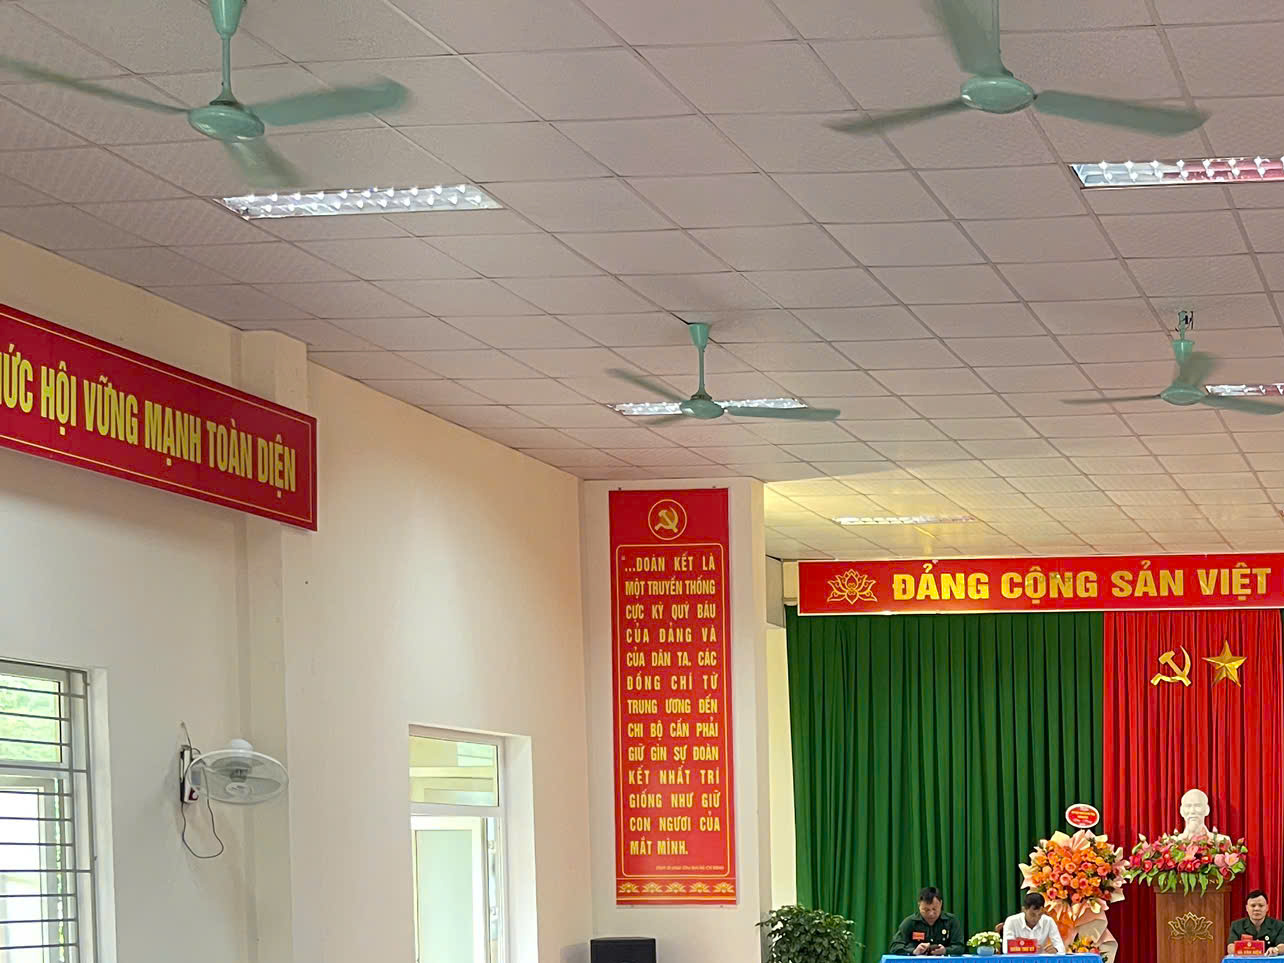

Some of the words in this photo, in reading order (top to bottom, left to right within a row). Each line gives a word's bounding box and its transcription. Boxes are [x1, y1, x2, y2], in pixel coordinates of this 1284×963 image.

[0, 343, 33, 413] ỨC
[41, 361, 76, 435] HỘI
[83, 375, 138, 445] VỮNG
[145, 400, 201, 466] MẠNH
[207, 418, 252, 479] TOÀN
[257, 434, 296, 498] DIỆN
[892, 562, 990, 600] ĐẢNG
[1001, 565, 1097, 604] CỘNG
[1111, 560, 1184, 598] SẢN
[1196, 562, 1271, 601] VIỆT
